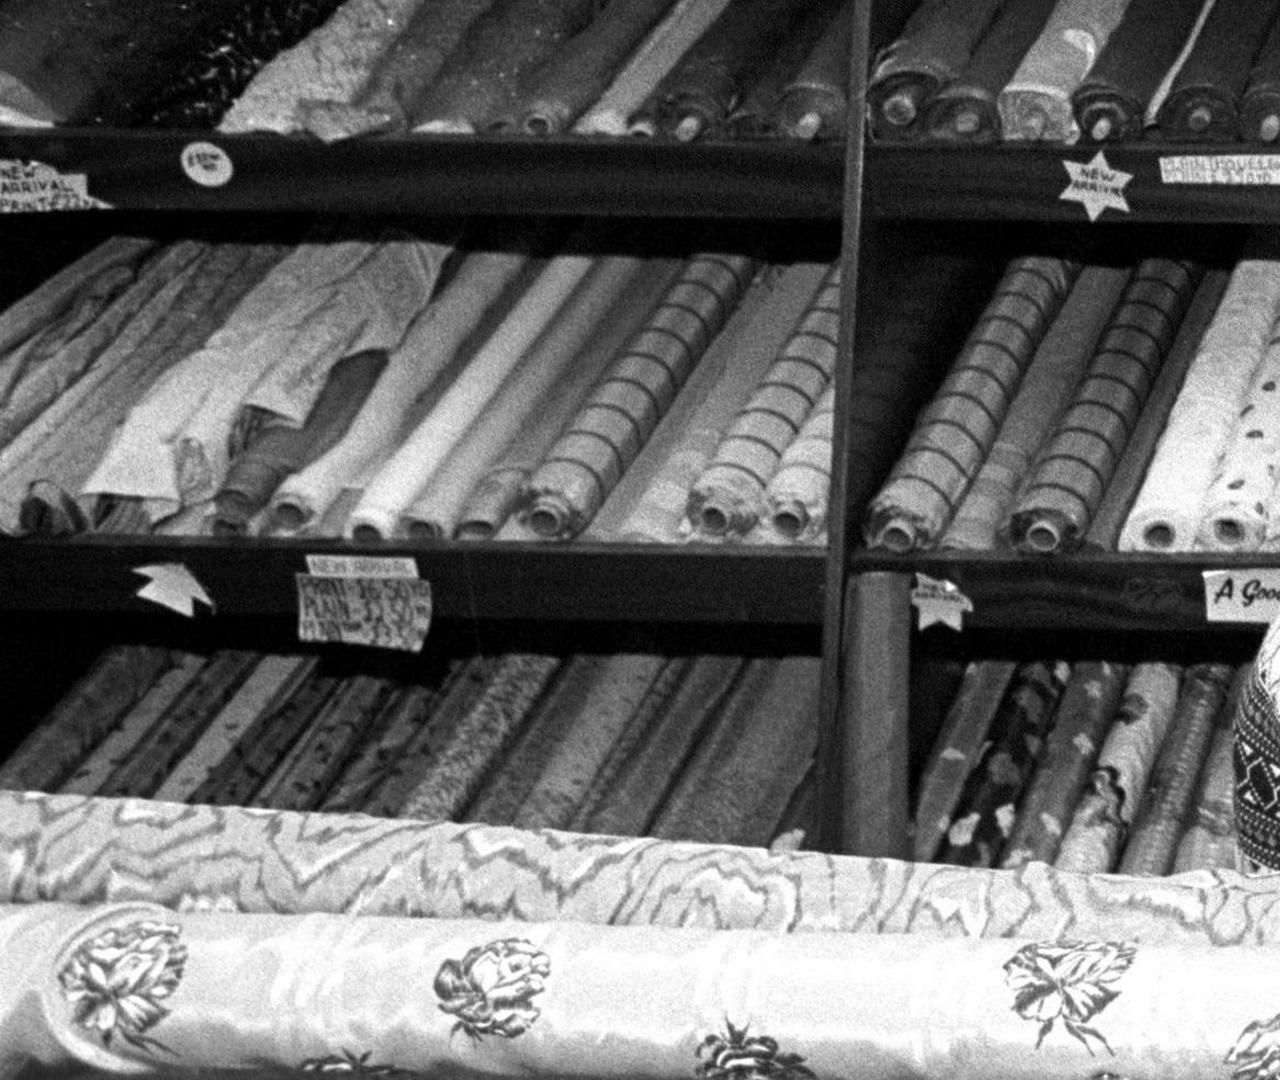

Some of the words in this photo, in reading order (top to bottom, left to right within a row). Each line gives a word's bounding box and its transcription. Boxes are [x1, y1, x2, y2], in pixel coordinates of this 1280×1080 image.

[1080, 167, 1116, 182] NEW
[1, 179, 74, 194] ARRIVAL
[1213, 576, 1234, 605] A
